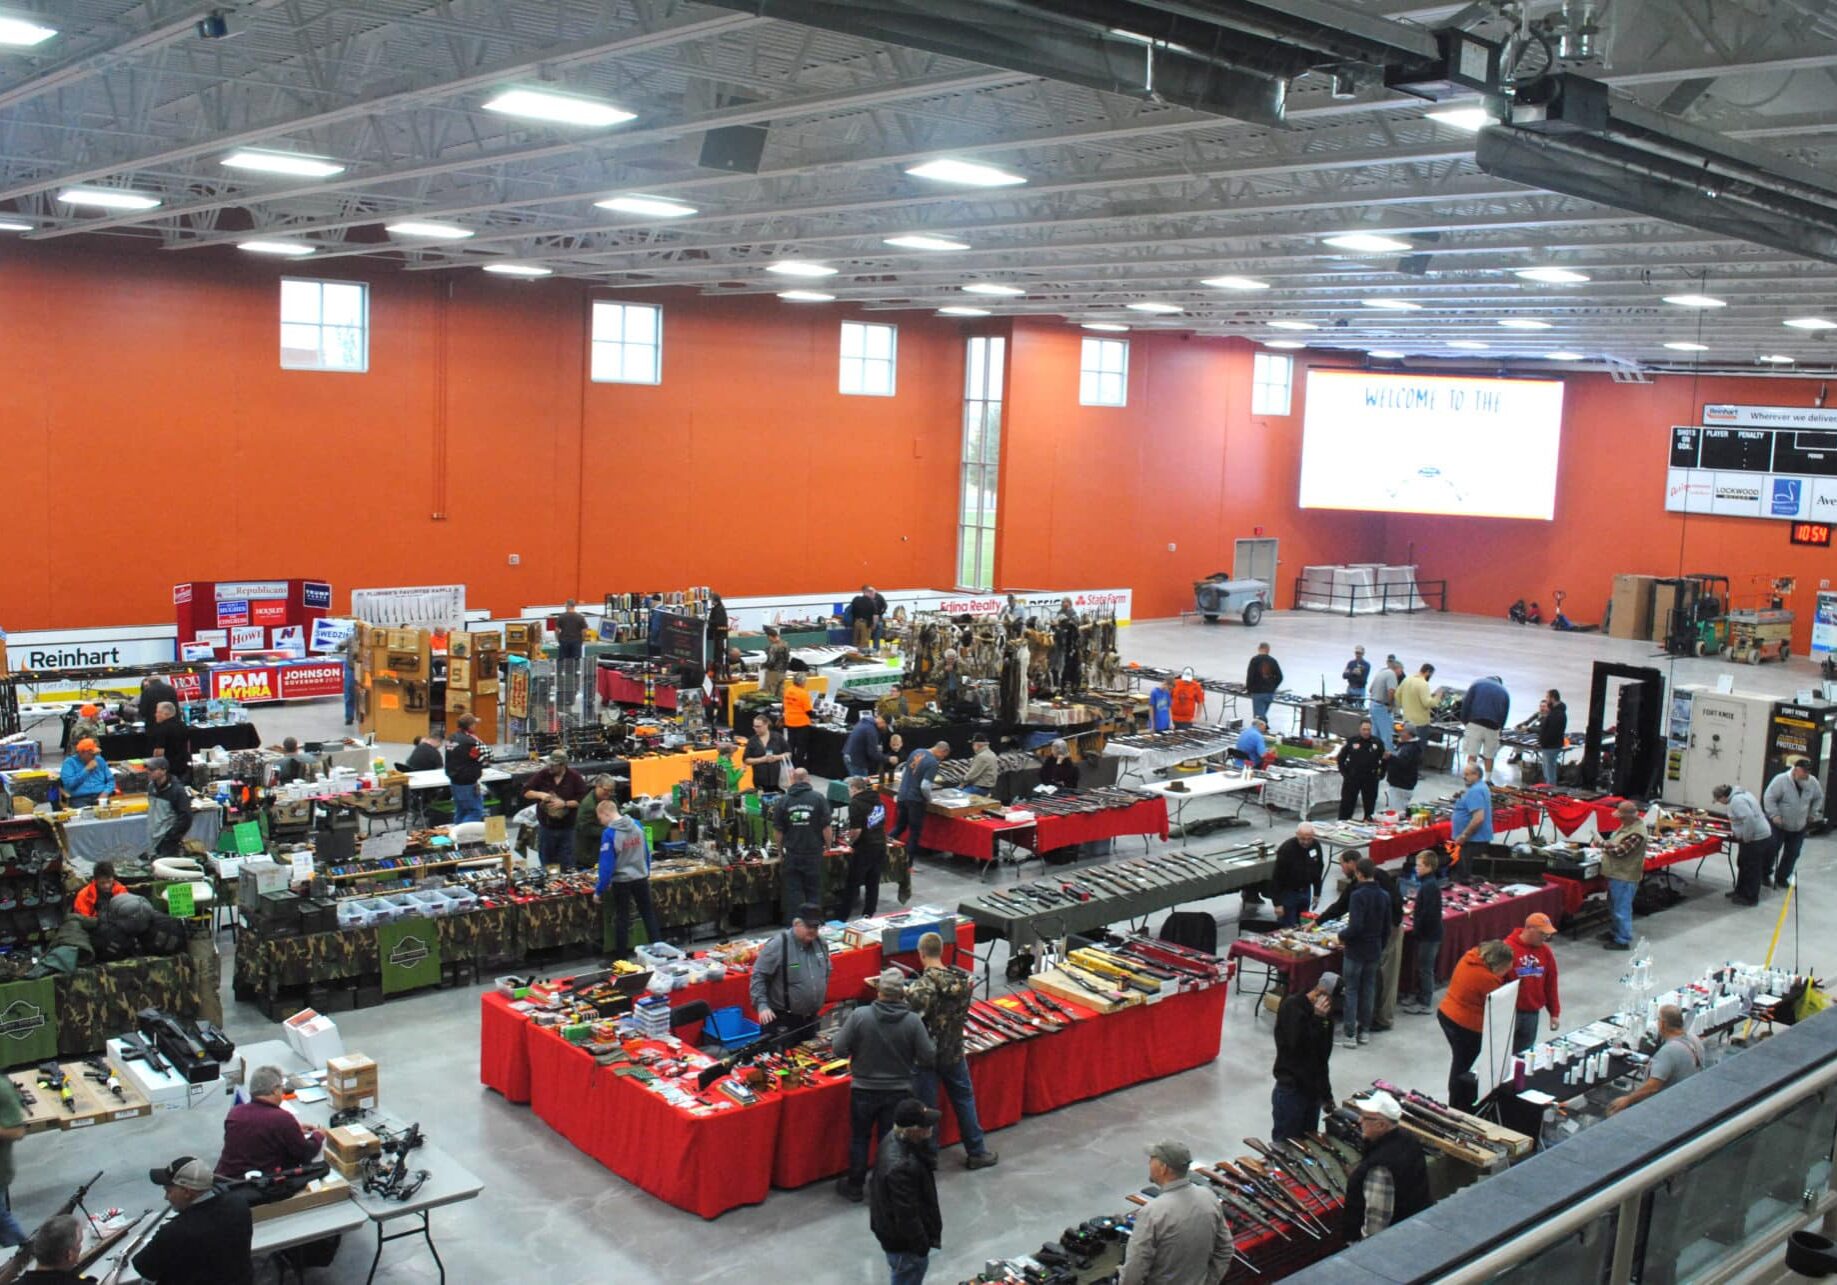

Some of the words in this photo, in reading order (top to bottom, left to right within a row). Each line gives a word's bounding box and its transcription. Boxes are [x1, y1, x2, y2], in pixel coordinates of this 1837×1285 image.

[1365, 386, 1437, 410] WELCOME
[1450, 388, 1465, 411] TO
[1475, 389, 1502, 413] THE
[1750, 411, 1791, 421] Wherever
[1706, 429, 1729, 438] PLAYER
[1738, 431, 1764, 440] PENALTY
[1716, 487, 1759, 496] LOCKWOOD
[236, 584, 288, 596] Republicans
[305, 588, 329, 597] TRUMP
[969, 598, 1001, 613] Realty
[232, 630, 263, 645] HOWE
[30, 647, 119, 669] Reinhart
[218, 672, 268, 688] PAM
[284, 668, 340, 680] JOHNSON
[284, 678, 324, 686] GOVERNOR
[219, 686, 272, 698] MYHRA
